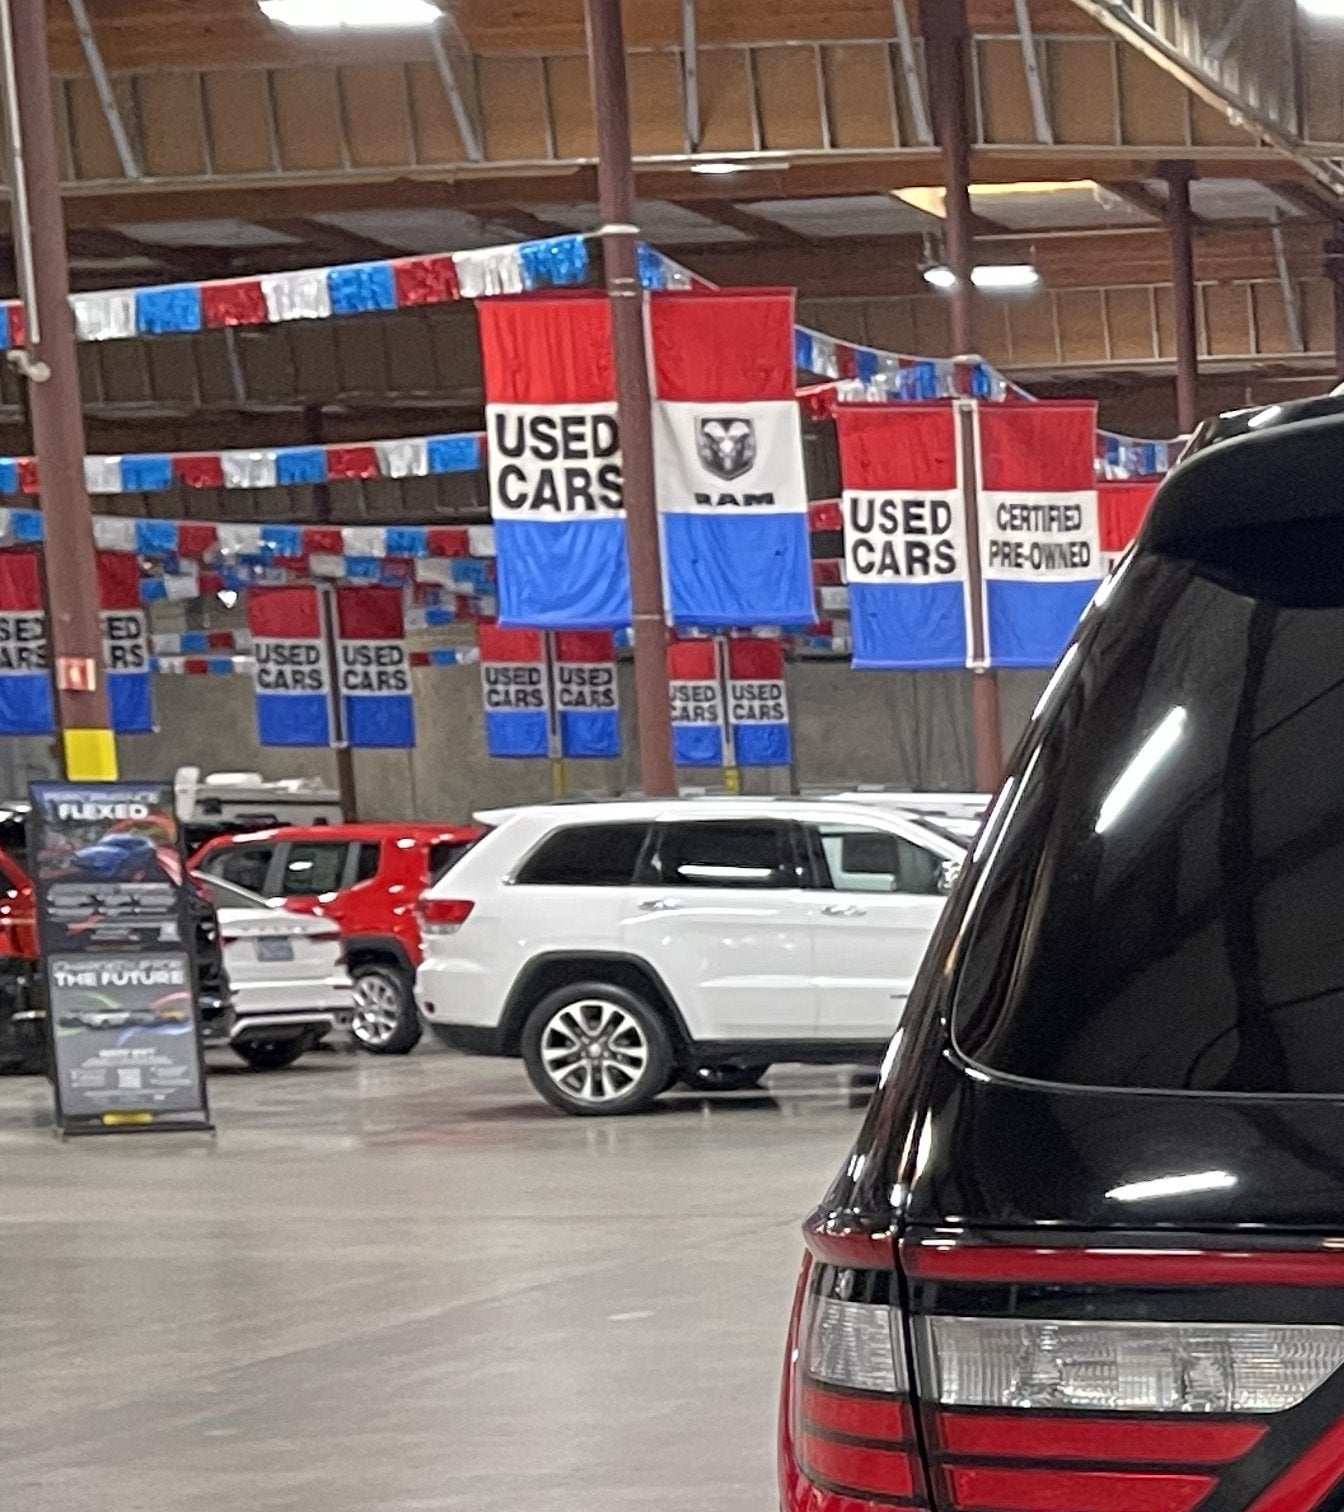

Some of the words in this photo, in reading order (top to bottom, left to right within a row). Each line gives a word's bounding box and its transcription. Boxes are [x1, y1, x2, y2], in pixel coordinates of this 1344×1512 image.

[496, 414, 620, 460] USED
[498, 464, 624, 511] CARS
[850, 498, 952, 535] USED
[997, 503, 1082, 532] CERTIFIED
[852, 538, 957, 576] CARS
[989, 540, 1091, 569] PRE-OWNED
[106, 616, 141, 640] ED
[110, 645, 144, 668] RS
[255, 643, 321, 666] USED
[342, 645, 404, 666] USED
[257, 668, 323, 690] CARS
[344, 670, 408, 691] CARS
[485, 667, 541, 685] USED
[560, 667, 613, 686] USED
[487, 688, 544, 707] CARS
[560, 688, 615, 706] CARS
[731, 684, 782, 701] USED
[732, 703, 784, 720] CARS
[53, 970, 98, 988] THE
[101, 969, 184, 987] FUTURE
